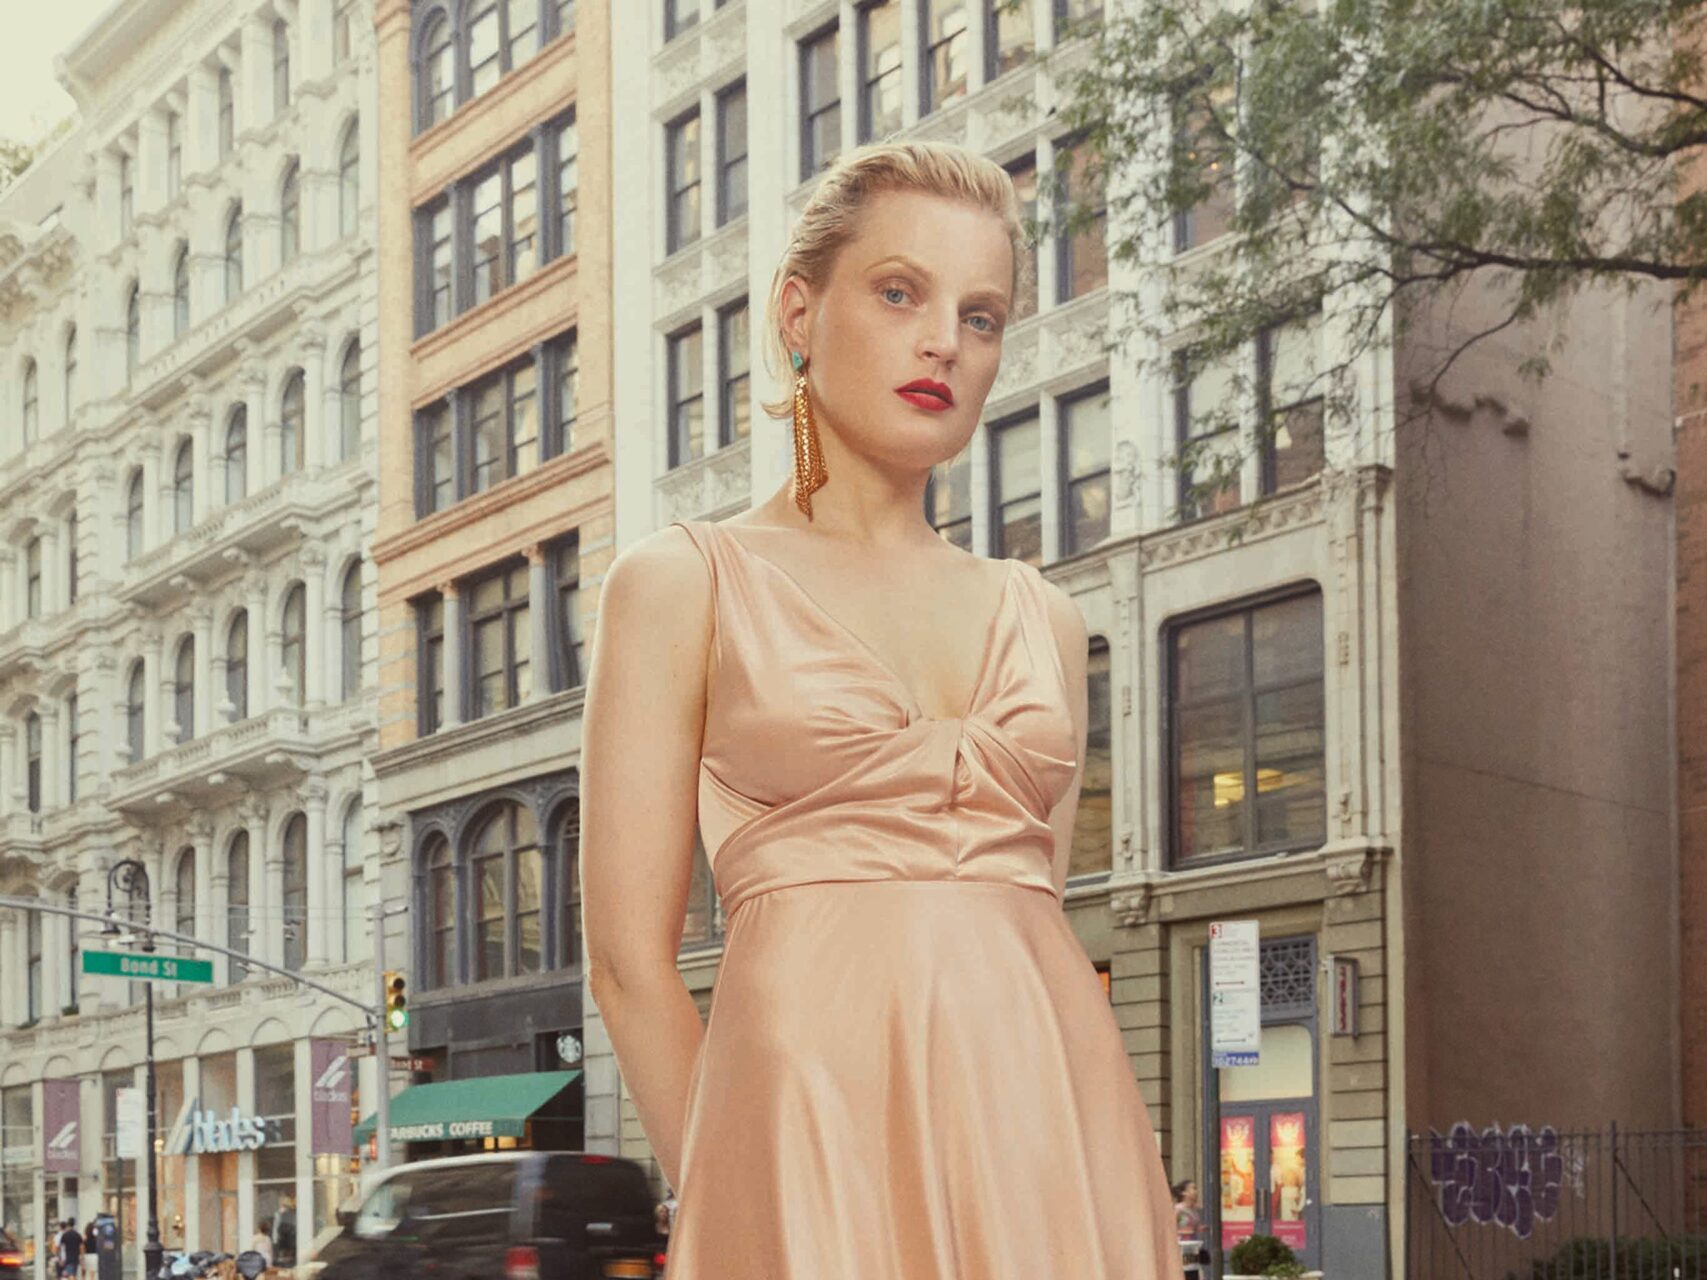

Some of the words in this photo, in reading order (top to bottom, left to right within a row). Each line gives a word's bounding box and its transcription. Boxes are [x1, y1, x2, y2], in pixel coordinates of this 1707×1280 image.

[120, 957, 158, 975] Bond
[162, 960, 178, 977] St
[193, 1106, 265, 1154] blades
[390, 1122, 444, 1140] ARBUCKS
[448, 1120, 494, 1136] COFFEE
